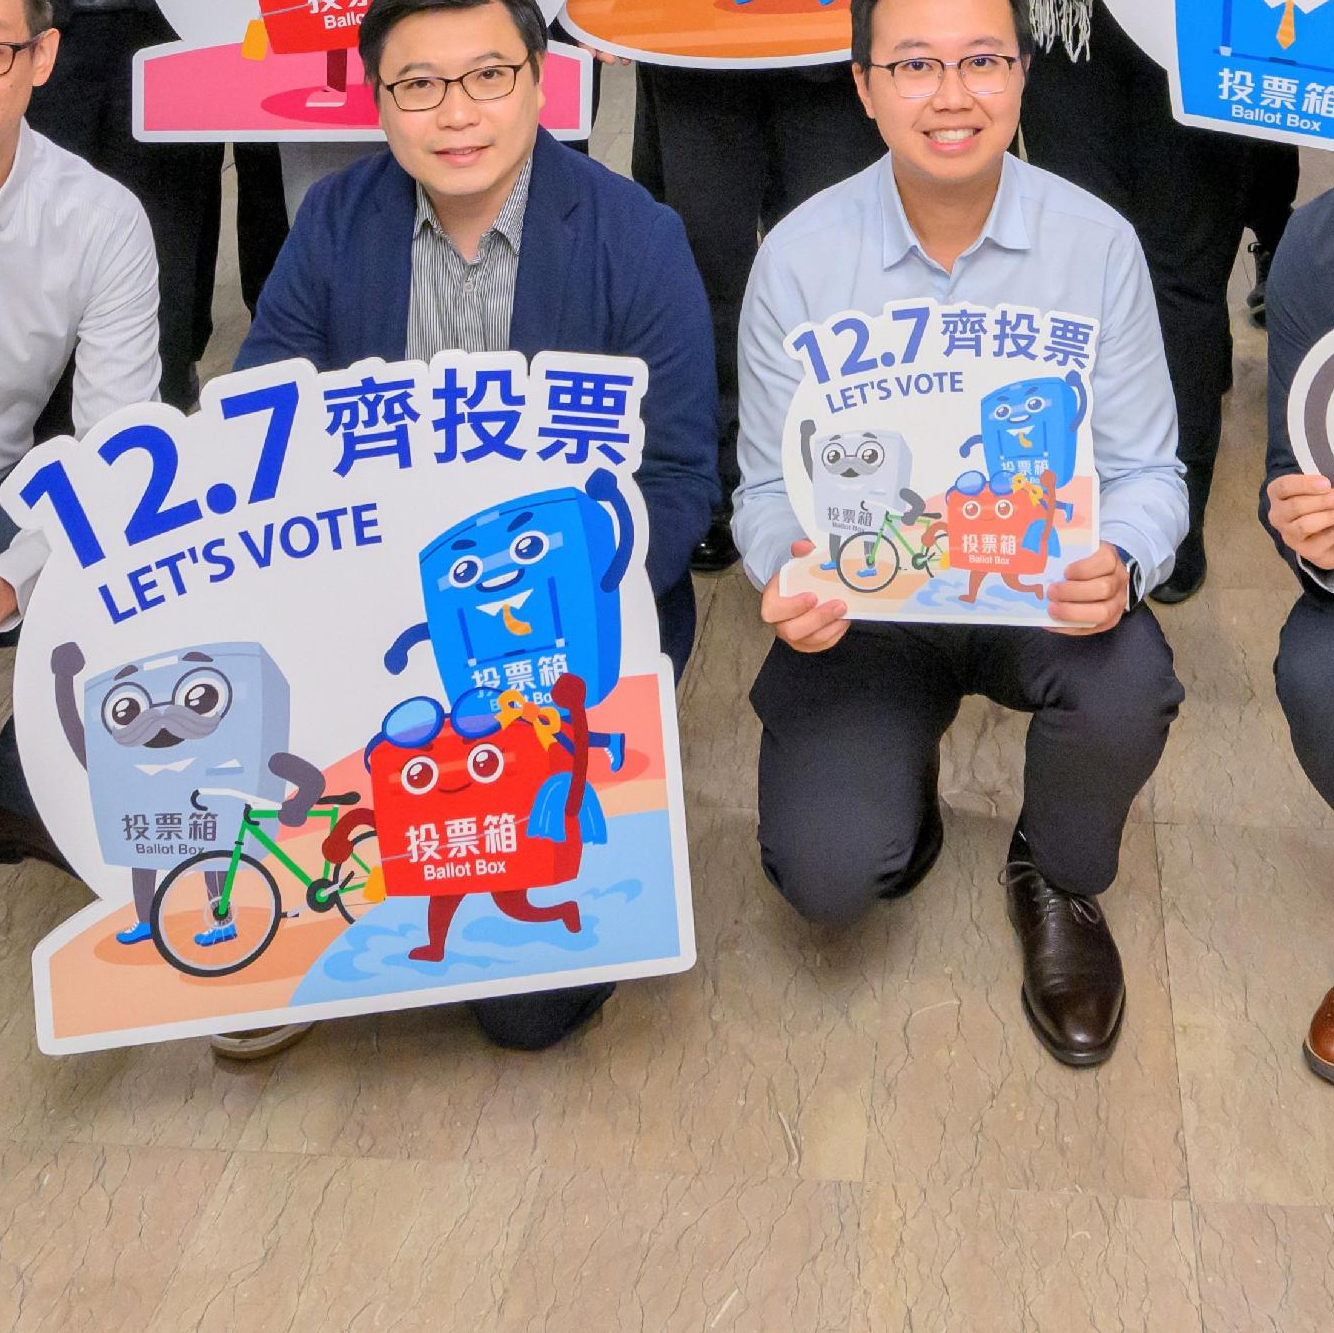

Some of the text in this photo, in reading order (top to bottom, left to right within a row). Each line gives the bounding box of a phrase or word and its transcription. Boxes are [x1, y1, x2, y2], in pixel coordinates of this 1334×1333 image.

[1230, 103, 1322, 133] Ballot Box
[792, 306, 1094, 386] 12.7 齊投票
[825, 371, 964, 415] LET'S VOTE
[20, 367, 635, 570] 12.7 齊投票
[962, 534, 1017, 556] 投票箱
[968, 554, 1010, 566] Ballot Box
[97, 502, 383, 626] LET'S VOTE
[471, 652, 569, 699] 投票箱
[532, 691, 553, 706] Bo
[121, 811, 219, 844] 投票箱
[404, 812, 520, 865] 投票箱
[135, 841, 206, 857] Ballot Box
[422, 858, 507, 881] Ballot Box
